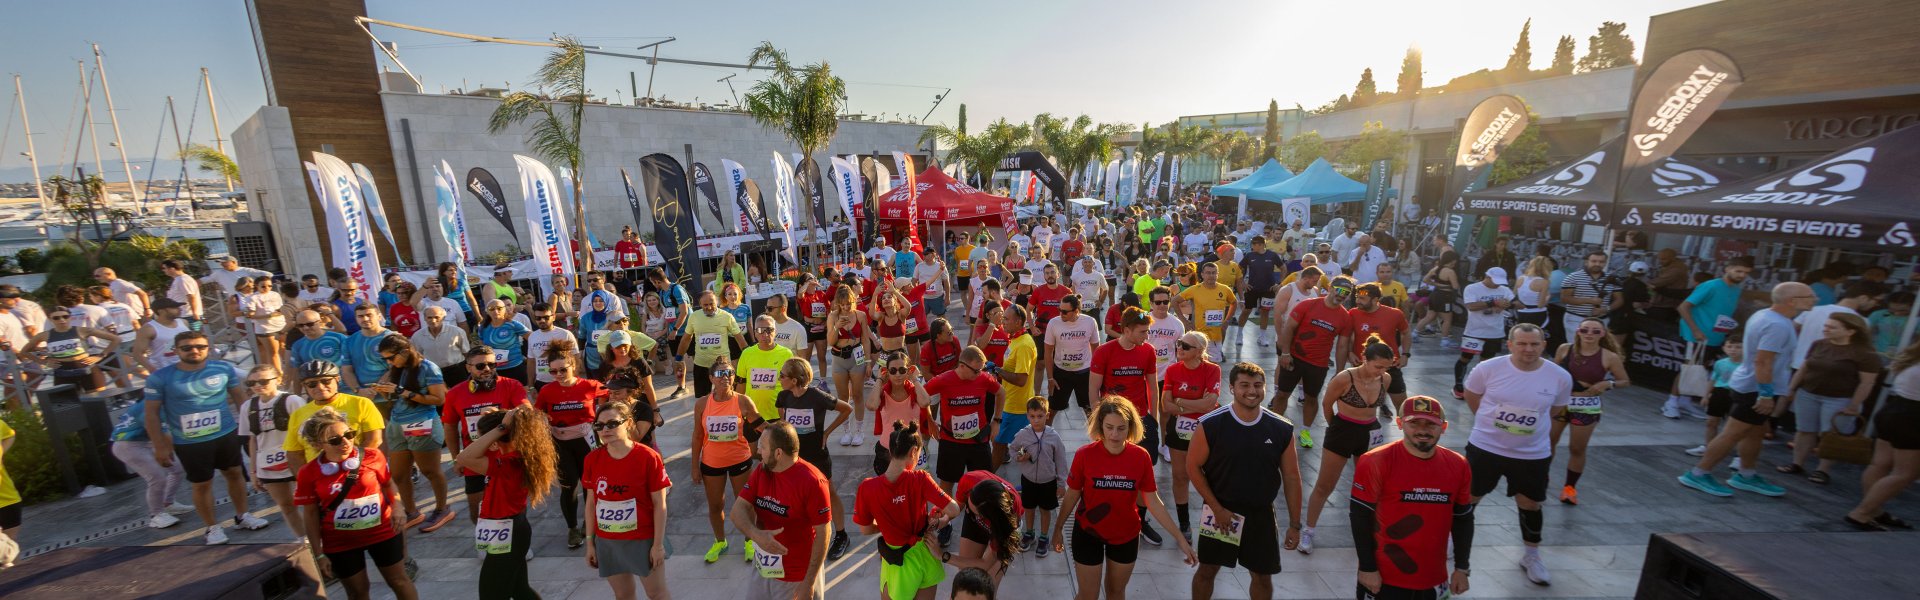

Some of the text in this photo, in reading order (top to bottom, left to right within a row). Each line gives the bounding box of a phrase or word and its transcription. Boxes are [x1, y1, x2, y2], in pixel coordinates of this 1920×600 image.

[1647, 64, 1715, 131] SEDOXY
[1662, 72, 1728, 135] SPORTS EVENTS
[1472, 106, 1515, 151] SEDOXY
[1001, 156, 1021, 169] NISH
[1507, 184, 1584, 196] SEDOXY
[1711, 191, 1856, 206] SEDOXY
[1470, 199, 1577, 216] SEDOXY SPORTS EVENTS
[1652, 211, 1863, 238] SEDOXY SPORTS EVENTS
[1207, 313, 1222, 321] 585
[700, 337, 720, 345] 1015
[1063, 353, 1083, 361] 1352
[1631, 351, 1682, 372] SPORT
[752, 373, 775, 383] 1181
[950, 398, 979, 406] RUNNERS
[1570, 397, 1599, 407] 1320
[186, 415, 217, 429] 1101
[788, 415, 811, 426] 658
[953, 418, 978, 431] 1408
[1496, 410, 1537, 427] 1049
[708, 421, 736, 433] 1156
[1370, 434, 1384, 445] 12
[1096, 480, 1134, 489] RUNNERS
[1404, 494, 1448, 502] RUNNERS
[337, 503, 379, 520] 1208
[756, 499, 786, 515] RUNNERS
[599, 508, 635, 521] 1287
[477, 528, 510, 541] 1376
[1200, 528, 1216, 537] 10K
